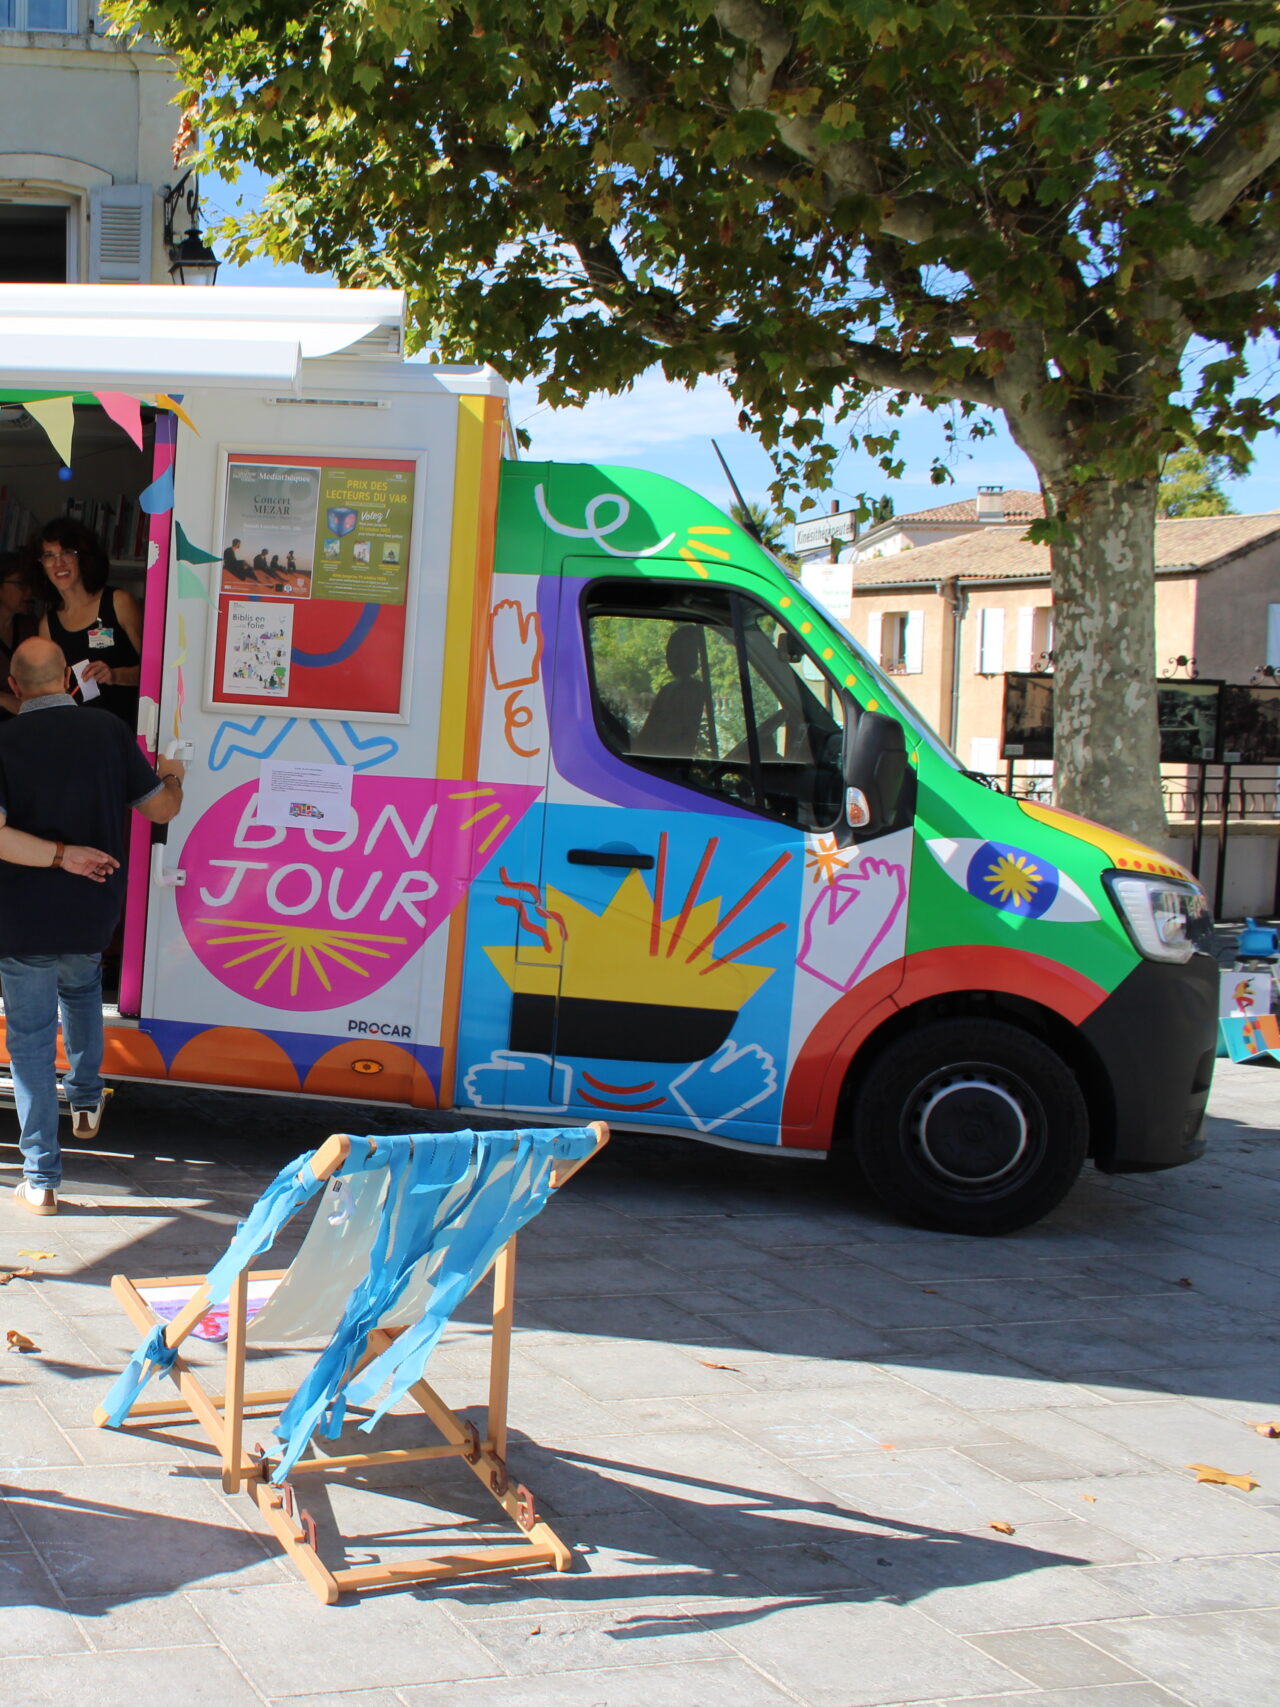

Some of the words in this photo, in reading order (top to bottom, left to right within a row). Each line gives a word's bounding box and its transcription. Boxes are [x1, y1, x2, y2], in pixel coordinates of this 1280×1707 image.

[346, 479, 368, 490] PRIX
[370, 481, 389, 491] DES
[326, 489, 371, 502] LECTEURS
[373, 492, 386, 502] DU
[388, 493, 408, 504] VAR
[233, 792, 438, 859] BON
[199, 859, 439, 929] JOUR
[347, 1019, 412, 1039] PROCAR
